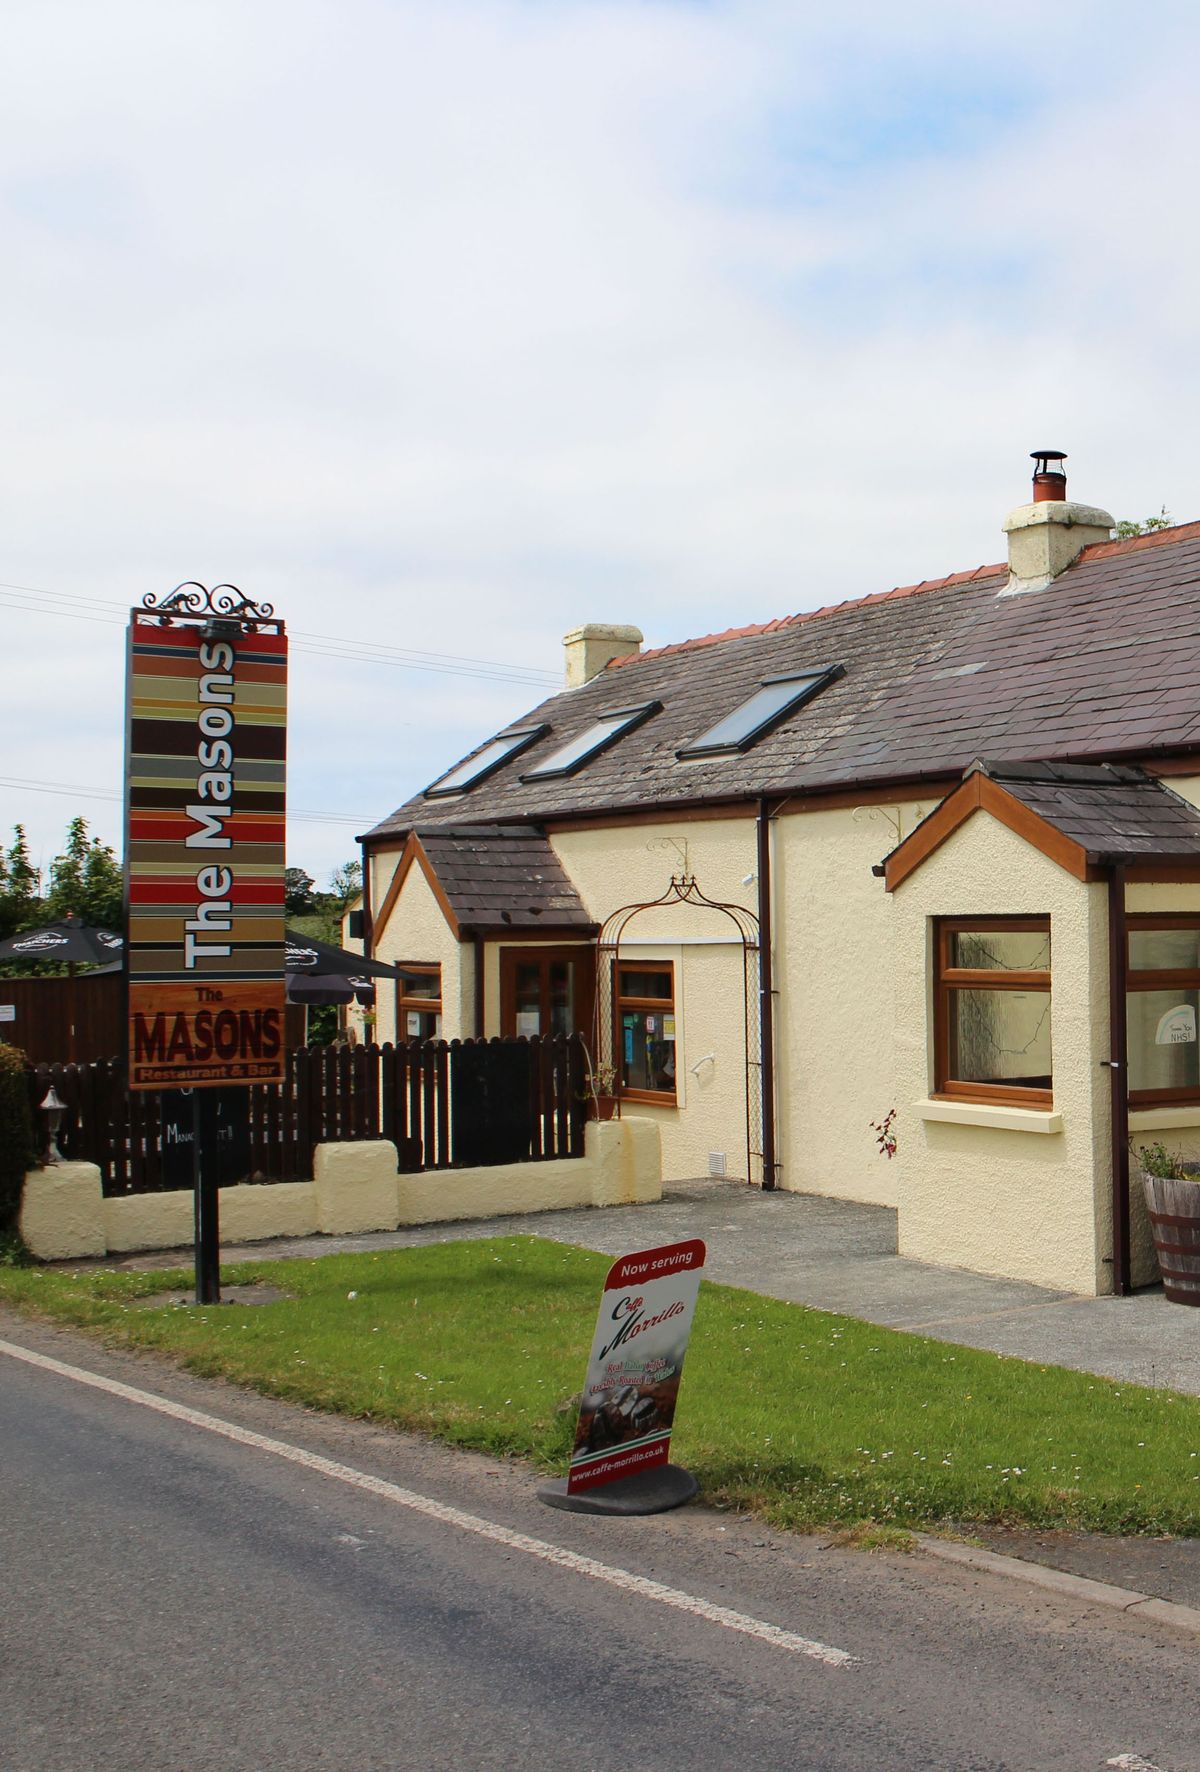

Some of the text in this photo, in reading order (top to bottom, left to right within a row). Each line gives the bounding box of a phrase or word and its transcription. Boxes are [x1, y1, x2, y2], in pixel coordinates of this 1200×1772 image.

[184, 641, 235, 969] The Masons
[194, 987, 223, 1001] The
[134, 1007, 281, 1063] MASONS
[140, 1064, 275, 1081] Restaurant & Bar
[621, 1251, 693, 1277] Now serving
[599, 1301, 685, 1360] Morrillo
[607, 1361, 623, 1373] Real
[571, 1446, 665, 1482] www.caffe-morrillo.co.uk
